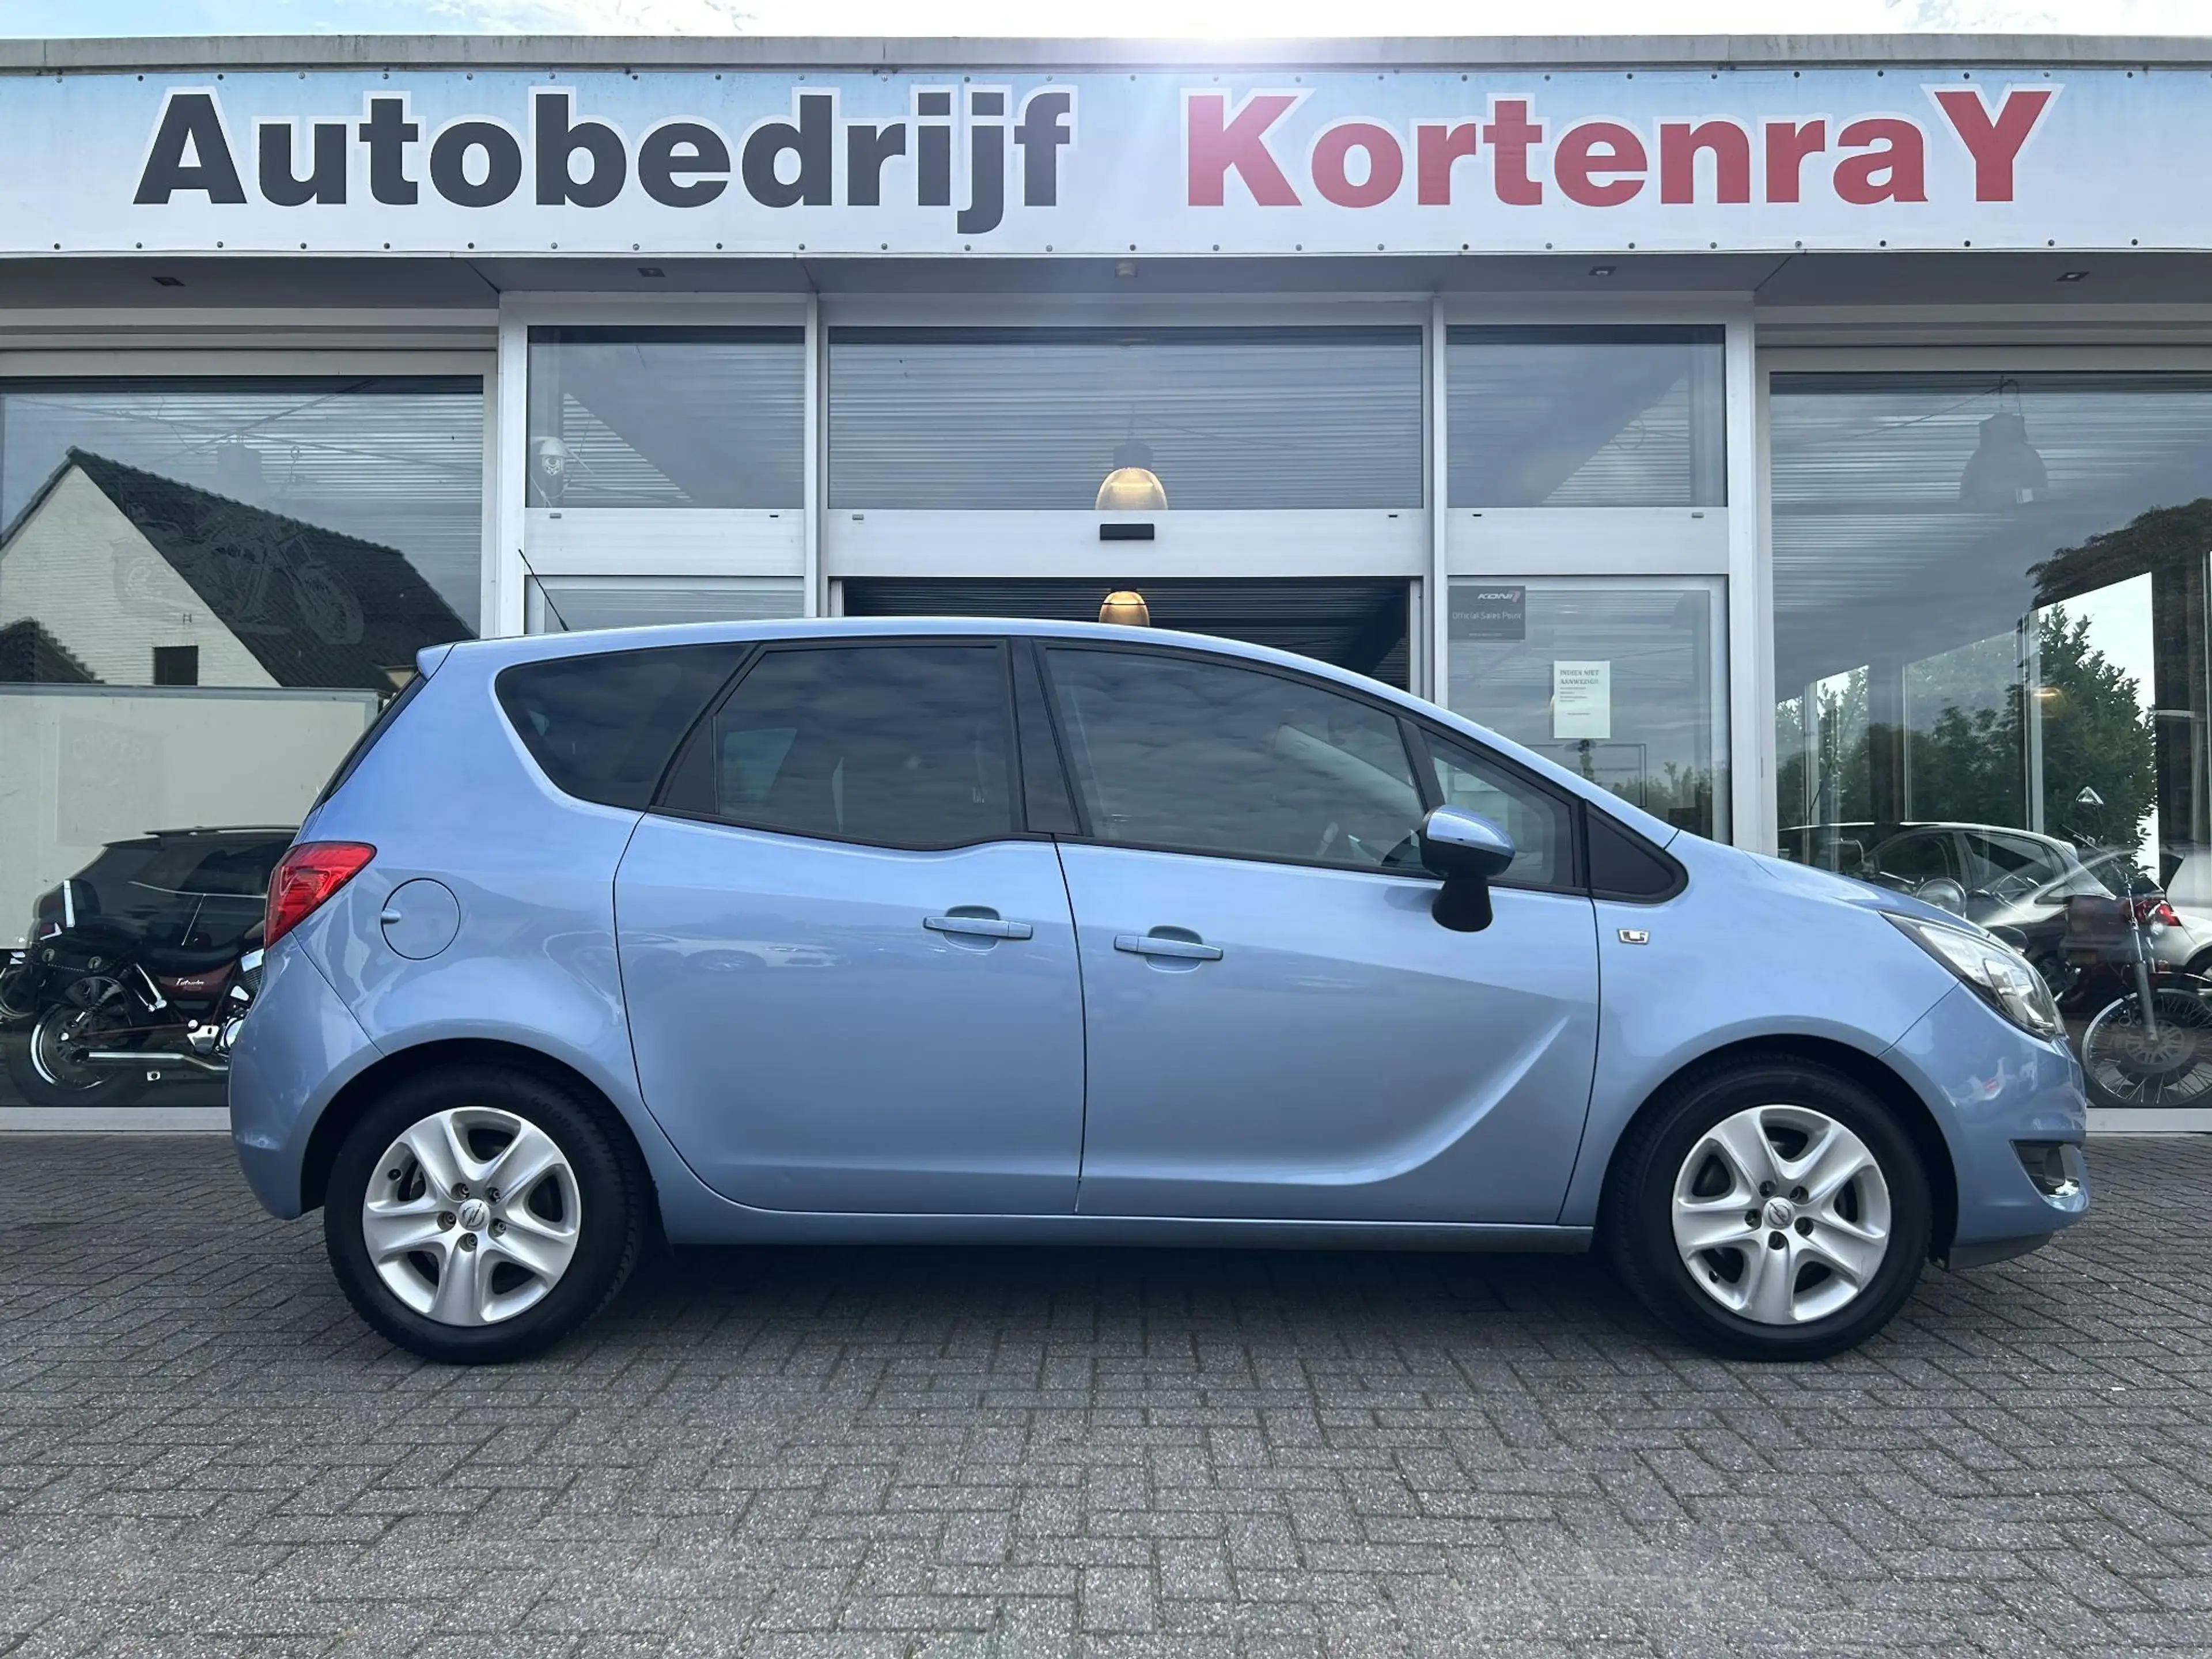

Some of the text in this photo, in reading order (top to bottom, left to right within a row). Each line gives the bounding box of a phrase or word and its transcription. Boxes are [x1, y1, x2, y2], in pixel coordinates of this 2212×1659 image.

[133, 91, 2052, 234] Autobedrijf KortenraY
[1480, 611, 1501, 620] Sales
[1502, 611, 1521, 620] Point
